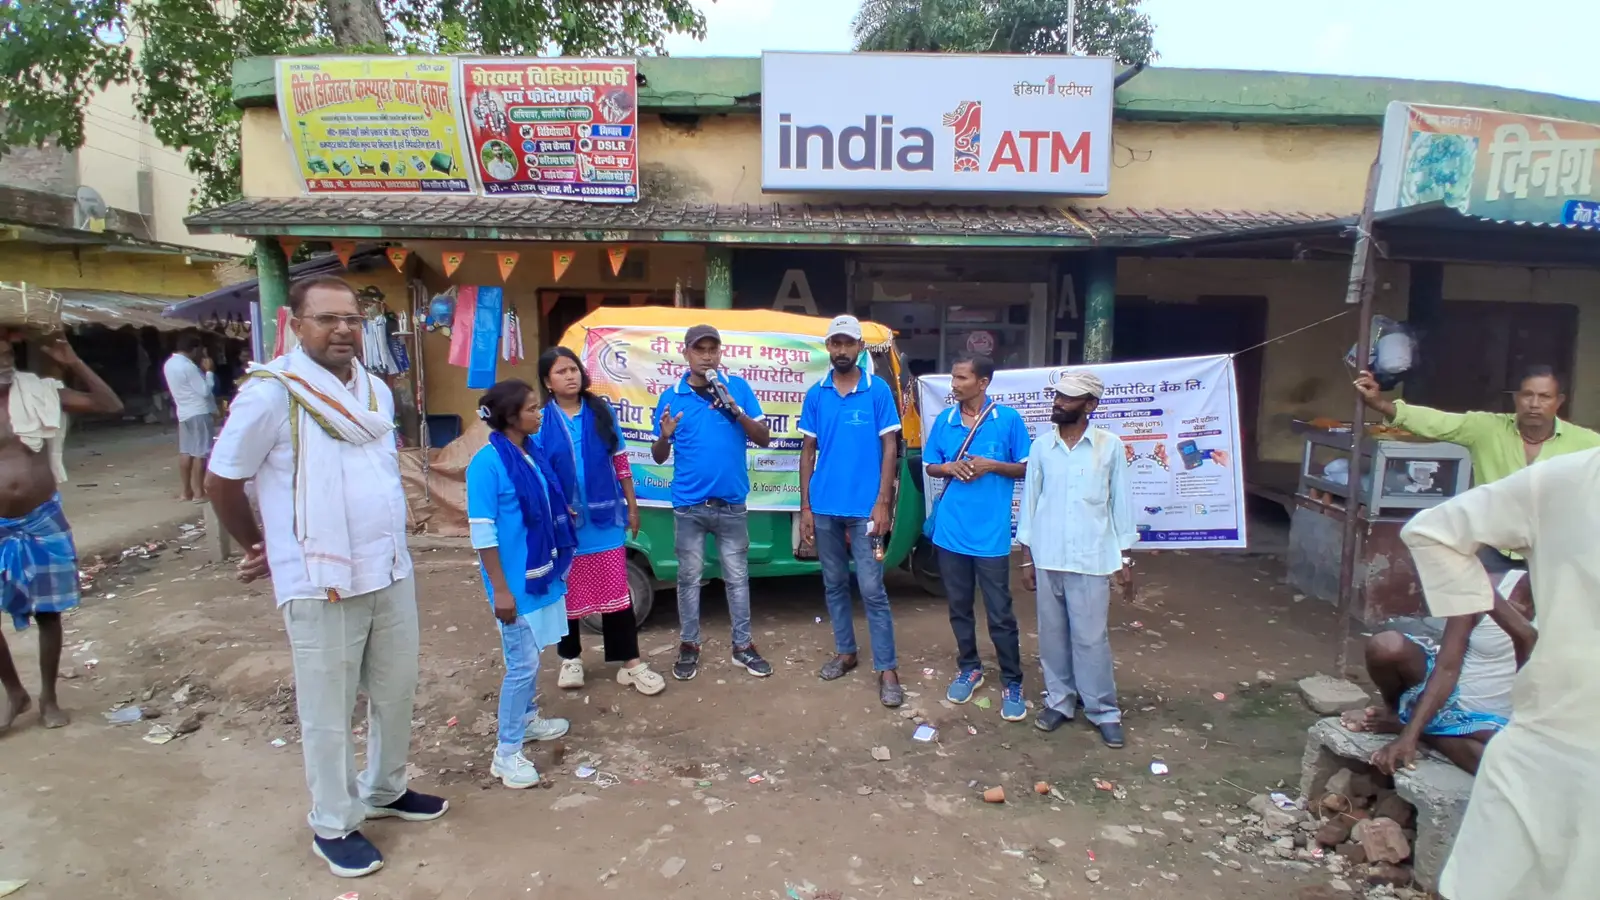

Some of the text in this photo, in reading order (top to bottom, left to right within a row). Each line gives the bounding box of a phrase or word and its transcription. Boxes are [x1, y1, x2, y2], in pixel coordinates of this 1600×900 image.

[312, 72, 351, 108] डिजिटल
[419, 80, 452, 118] दुकान
[501, 87, 595, 104] एवं फोटोग्राफी
[1013, 81, 1045, 96] इंडिया
[1058, 81, 1093, 98] एटीएम
[597, 141, 626, 151] DSLR
[779, 112, 935, 171] india
[987, 131, 1091, 173] ATM
[1485, 122, 1600, 201] दिनेश
[650, 336, 671, 354] दी
[760, 345, 810, 366] भभुआ
[1008, 390, 1040, 404] भभुआ
[1160, 380, 1182, 394] बैंक
[1185, 377, 1206, 392] लि.
[1145, 420, 1164, 428] (OTS)
[780, 440, 799, 448] Under
[753, 483, 758, 492] &
[760, 483, 781, 494] Young
